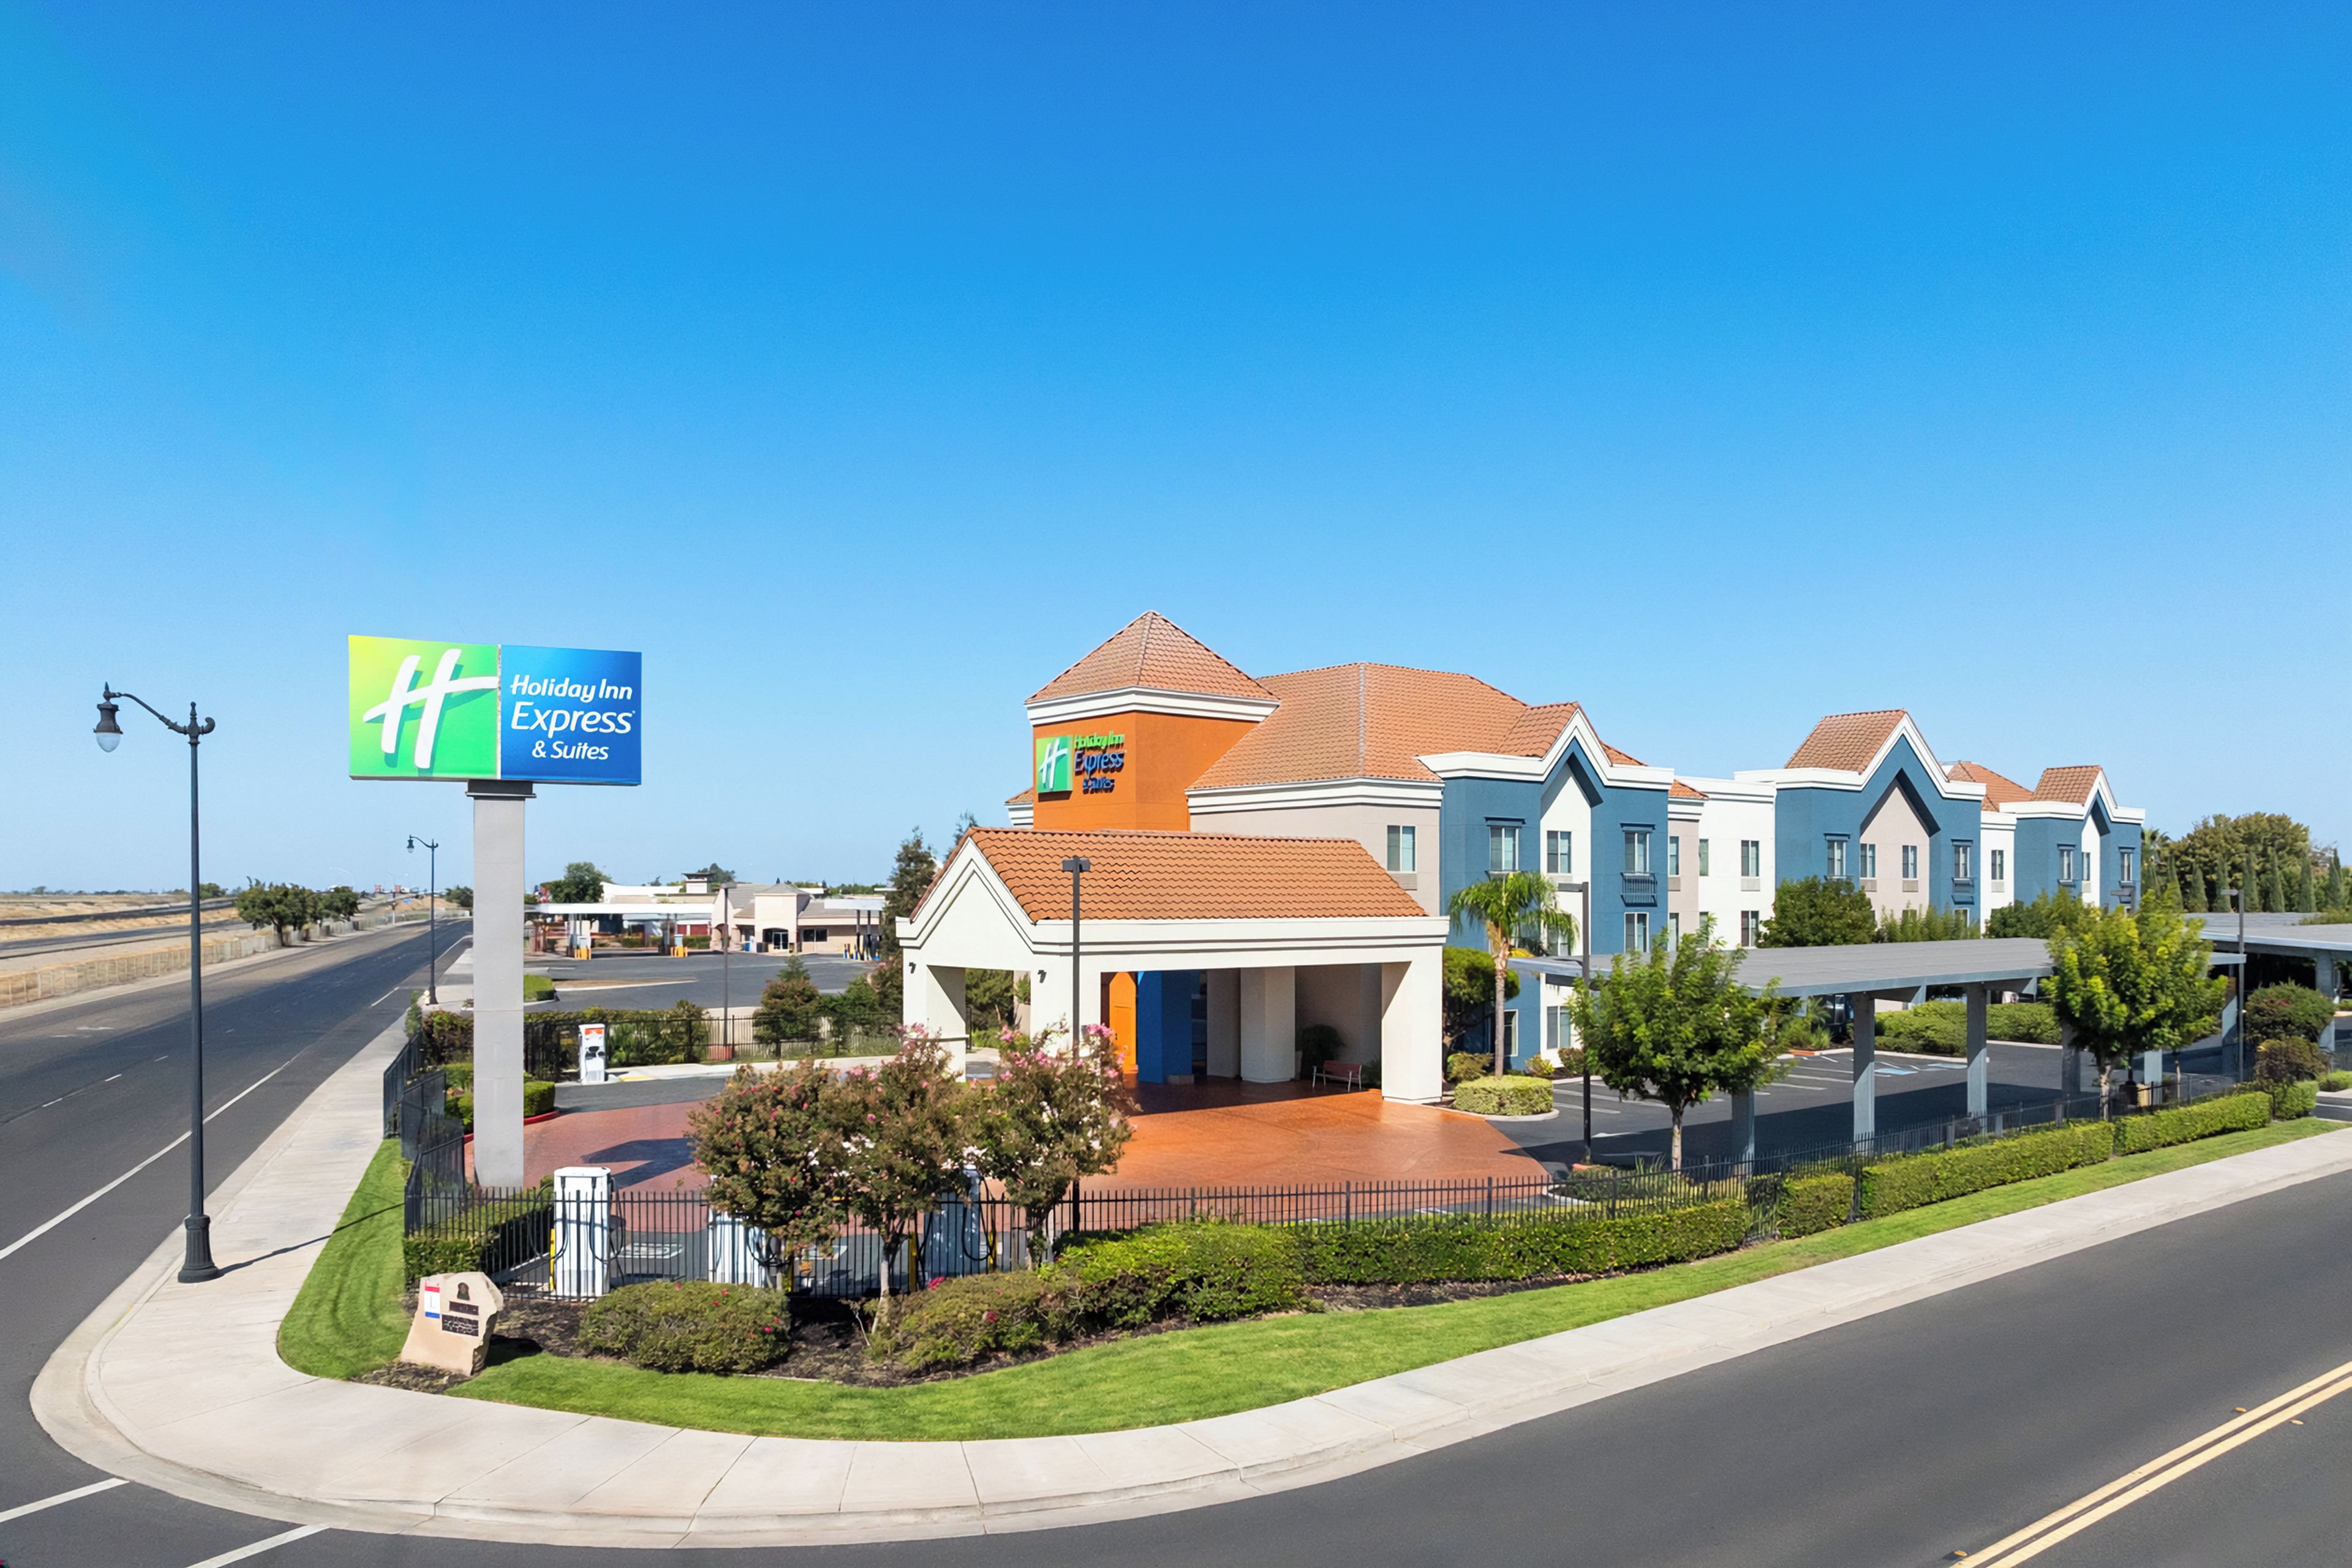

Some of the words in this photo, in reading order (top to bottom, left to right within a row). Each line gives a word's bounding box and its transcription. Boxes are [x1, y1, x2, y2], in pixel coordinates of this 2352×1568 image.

[510, 674, 596, 703] Holiday
[598, 679, 633, 699] Inn
[511, 701, 632, 739] Express
[532, 741, 546, 758] &
[550, 741, 609, 760] Suites
